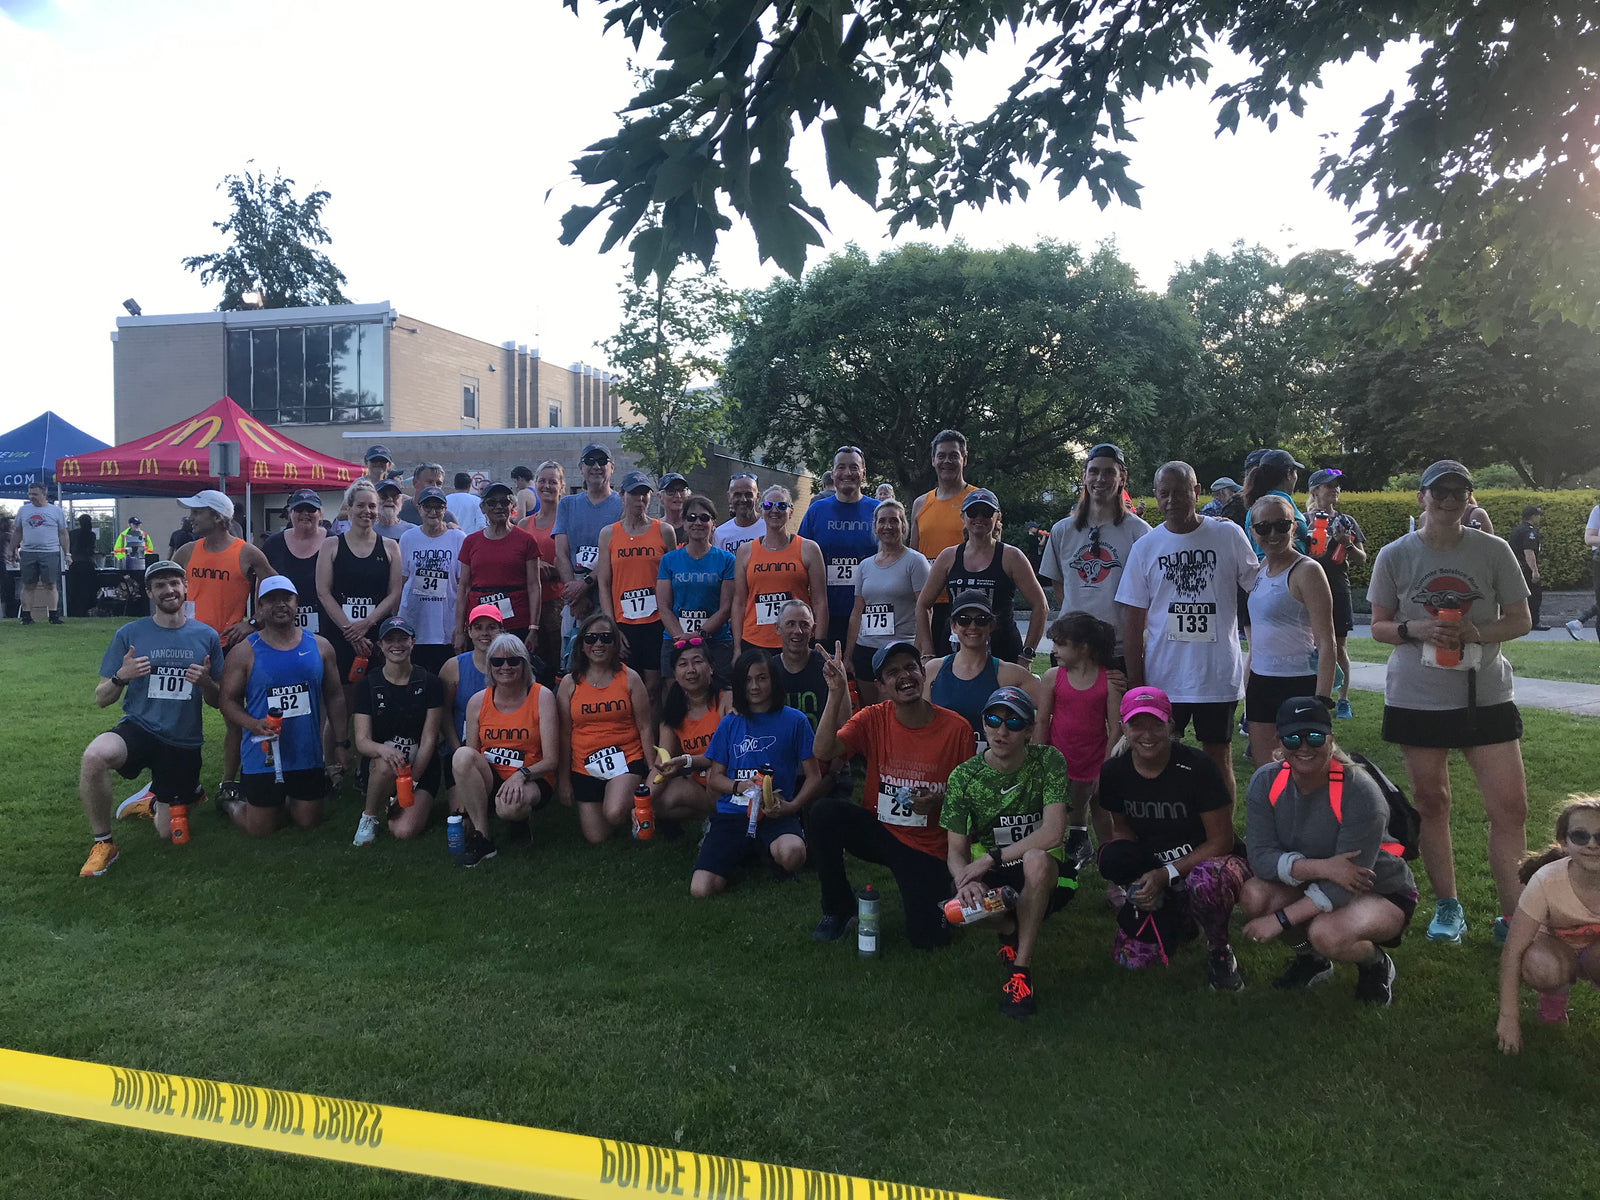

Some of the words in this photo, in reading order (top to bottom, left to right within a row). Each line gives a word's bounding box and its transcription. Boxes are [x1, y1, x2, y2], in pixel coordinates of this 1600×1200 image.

[582, 552, 597, 563] 87
[837, 566, 852, 580] 25
[423, 577, 438, 591] 34
[352, 606, 368, 619] 60
[630, 598, 645, 613] 17
[765, 603, 781, 618] 75
[687, 620, 701, 633] 26
[866, 614, 888, 629] 175
[1176, 615, 1208, 634] 133
[150, 649, 194, 660] VANCOUVER
[158, 677, 185, 693] 101
[280, 695, 299, 711] 62
[597, 756, 615, 774] 18
[1010, 824, 1035, 843] 64
